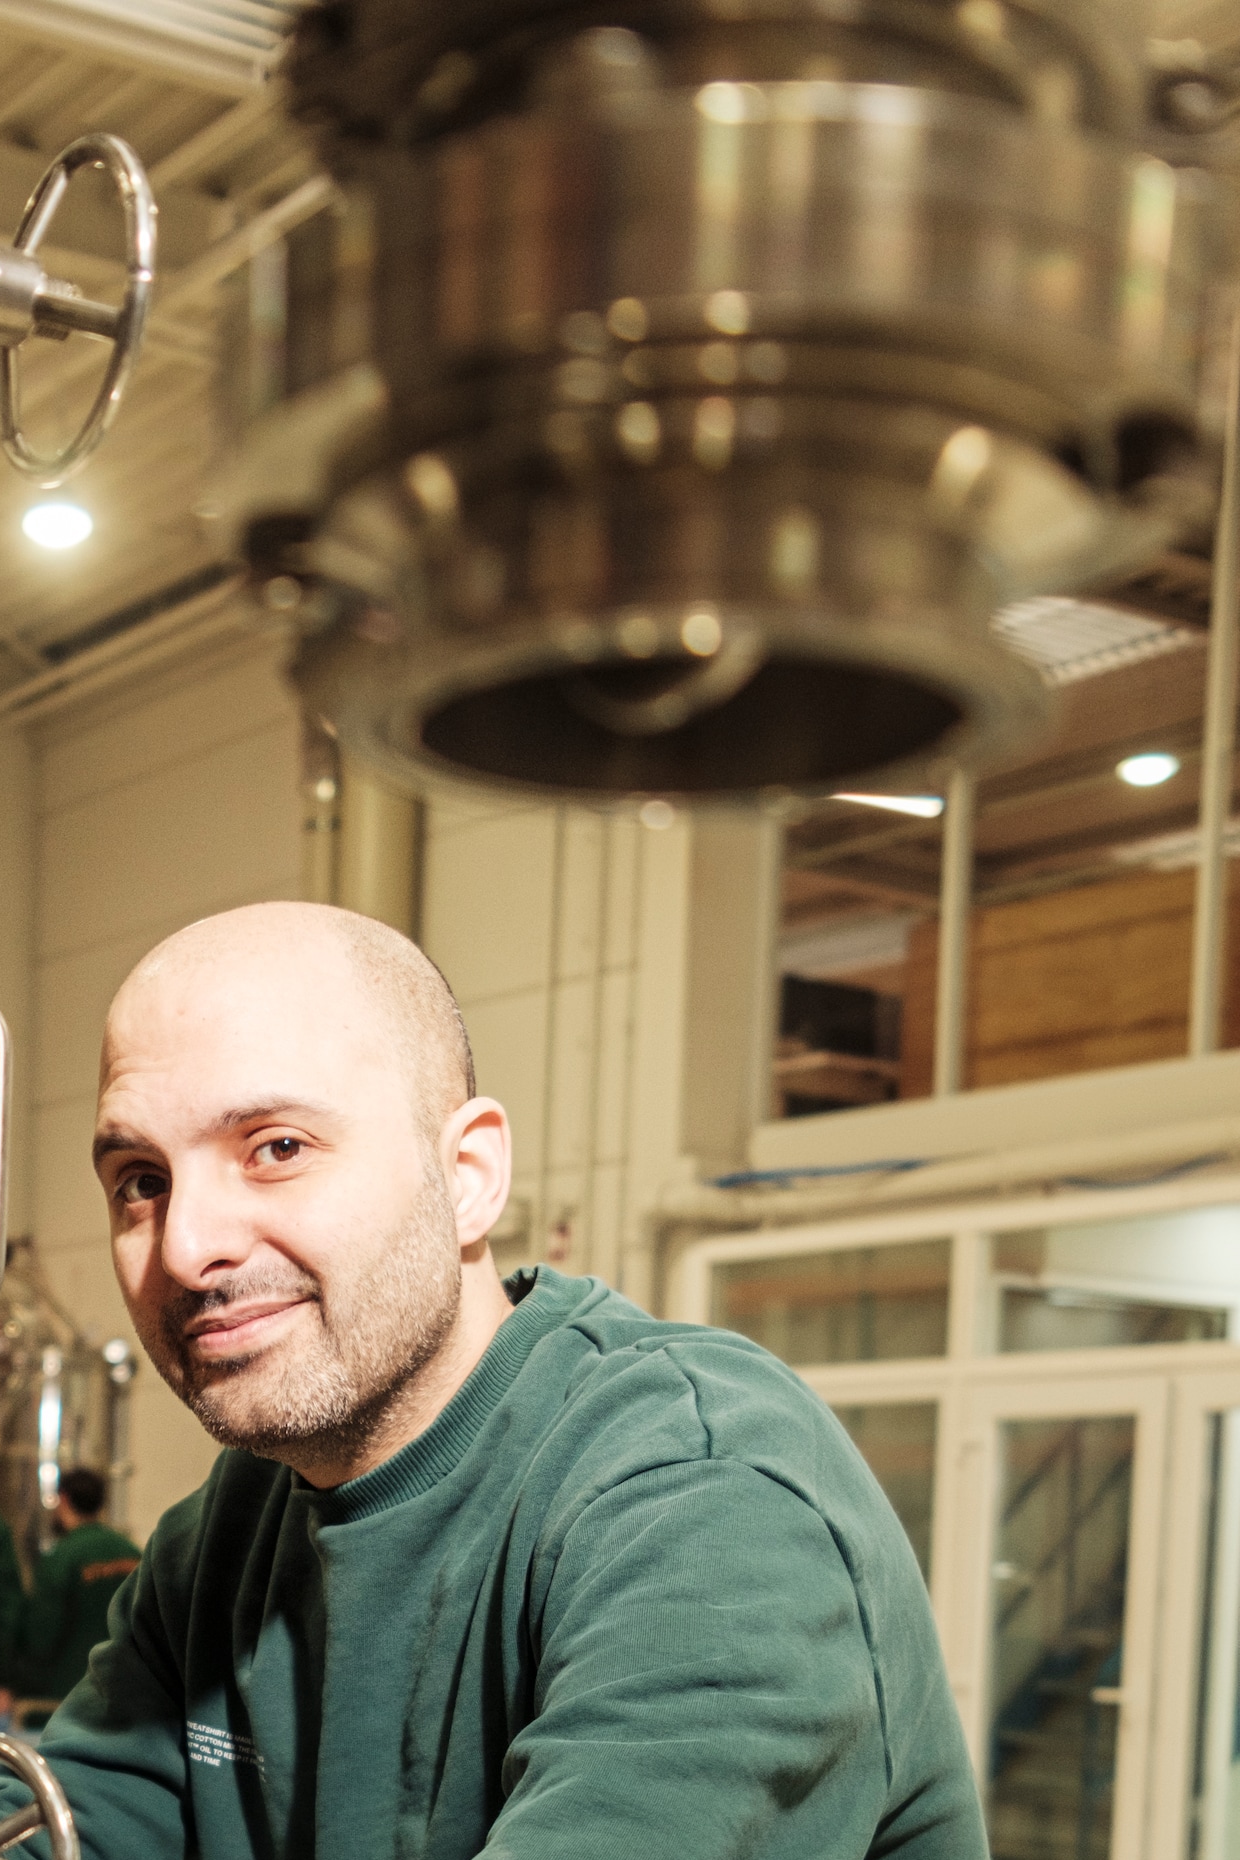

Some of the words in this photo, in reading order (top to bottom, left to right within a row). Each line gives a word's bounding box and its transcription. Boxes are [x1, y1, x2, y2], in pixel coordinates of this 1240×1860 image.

[187, 1720, 226, 1738] WEATSHIRT
[194, 1733, 223, 1747] COTTON
[199, 1745, 211, 1754] OIL
[213, 1748, 223, 1757] TO
[190, 1752, 202, 1761] AND
[203, 1755, 221, 1767] TIME
